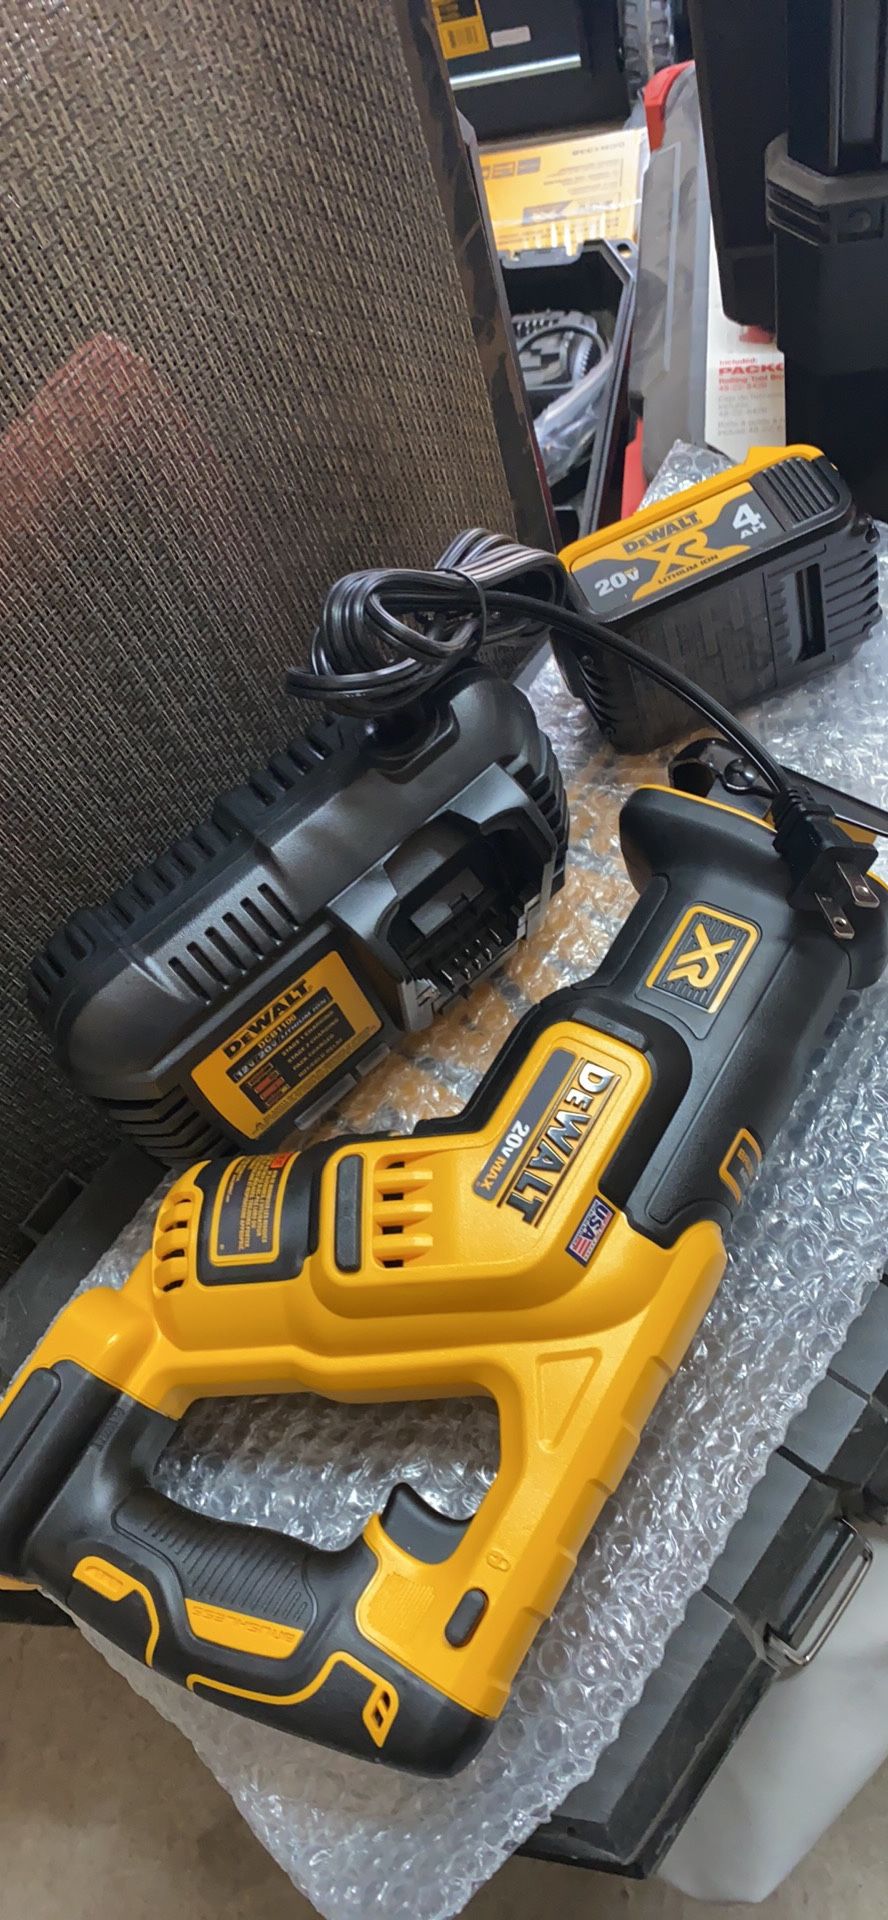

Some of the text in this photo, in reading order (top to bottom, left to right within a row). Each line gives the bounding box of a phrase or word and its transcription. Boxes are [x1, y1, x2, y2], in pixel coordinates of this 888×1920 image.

[731, 502, 763, 531] 4
[739, 521, 768, 540] AH
[657, 553, 719, 585] LITHIUM ION
[667, 922, 736, 988] XR
[223, 979, 308, 1059] DEWALT
[506, 1060, 615, 1226] DEWALT
[479, 1156, 508, 1191] MAX
[586, 1203, 613, 1241] USA
